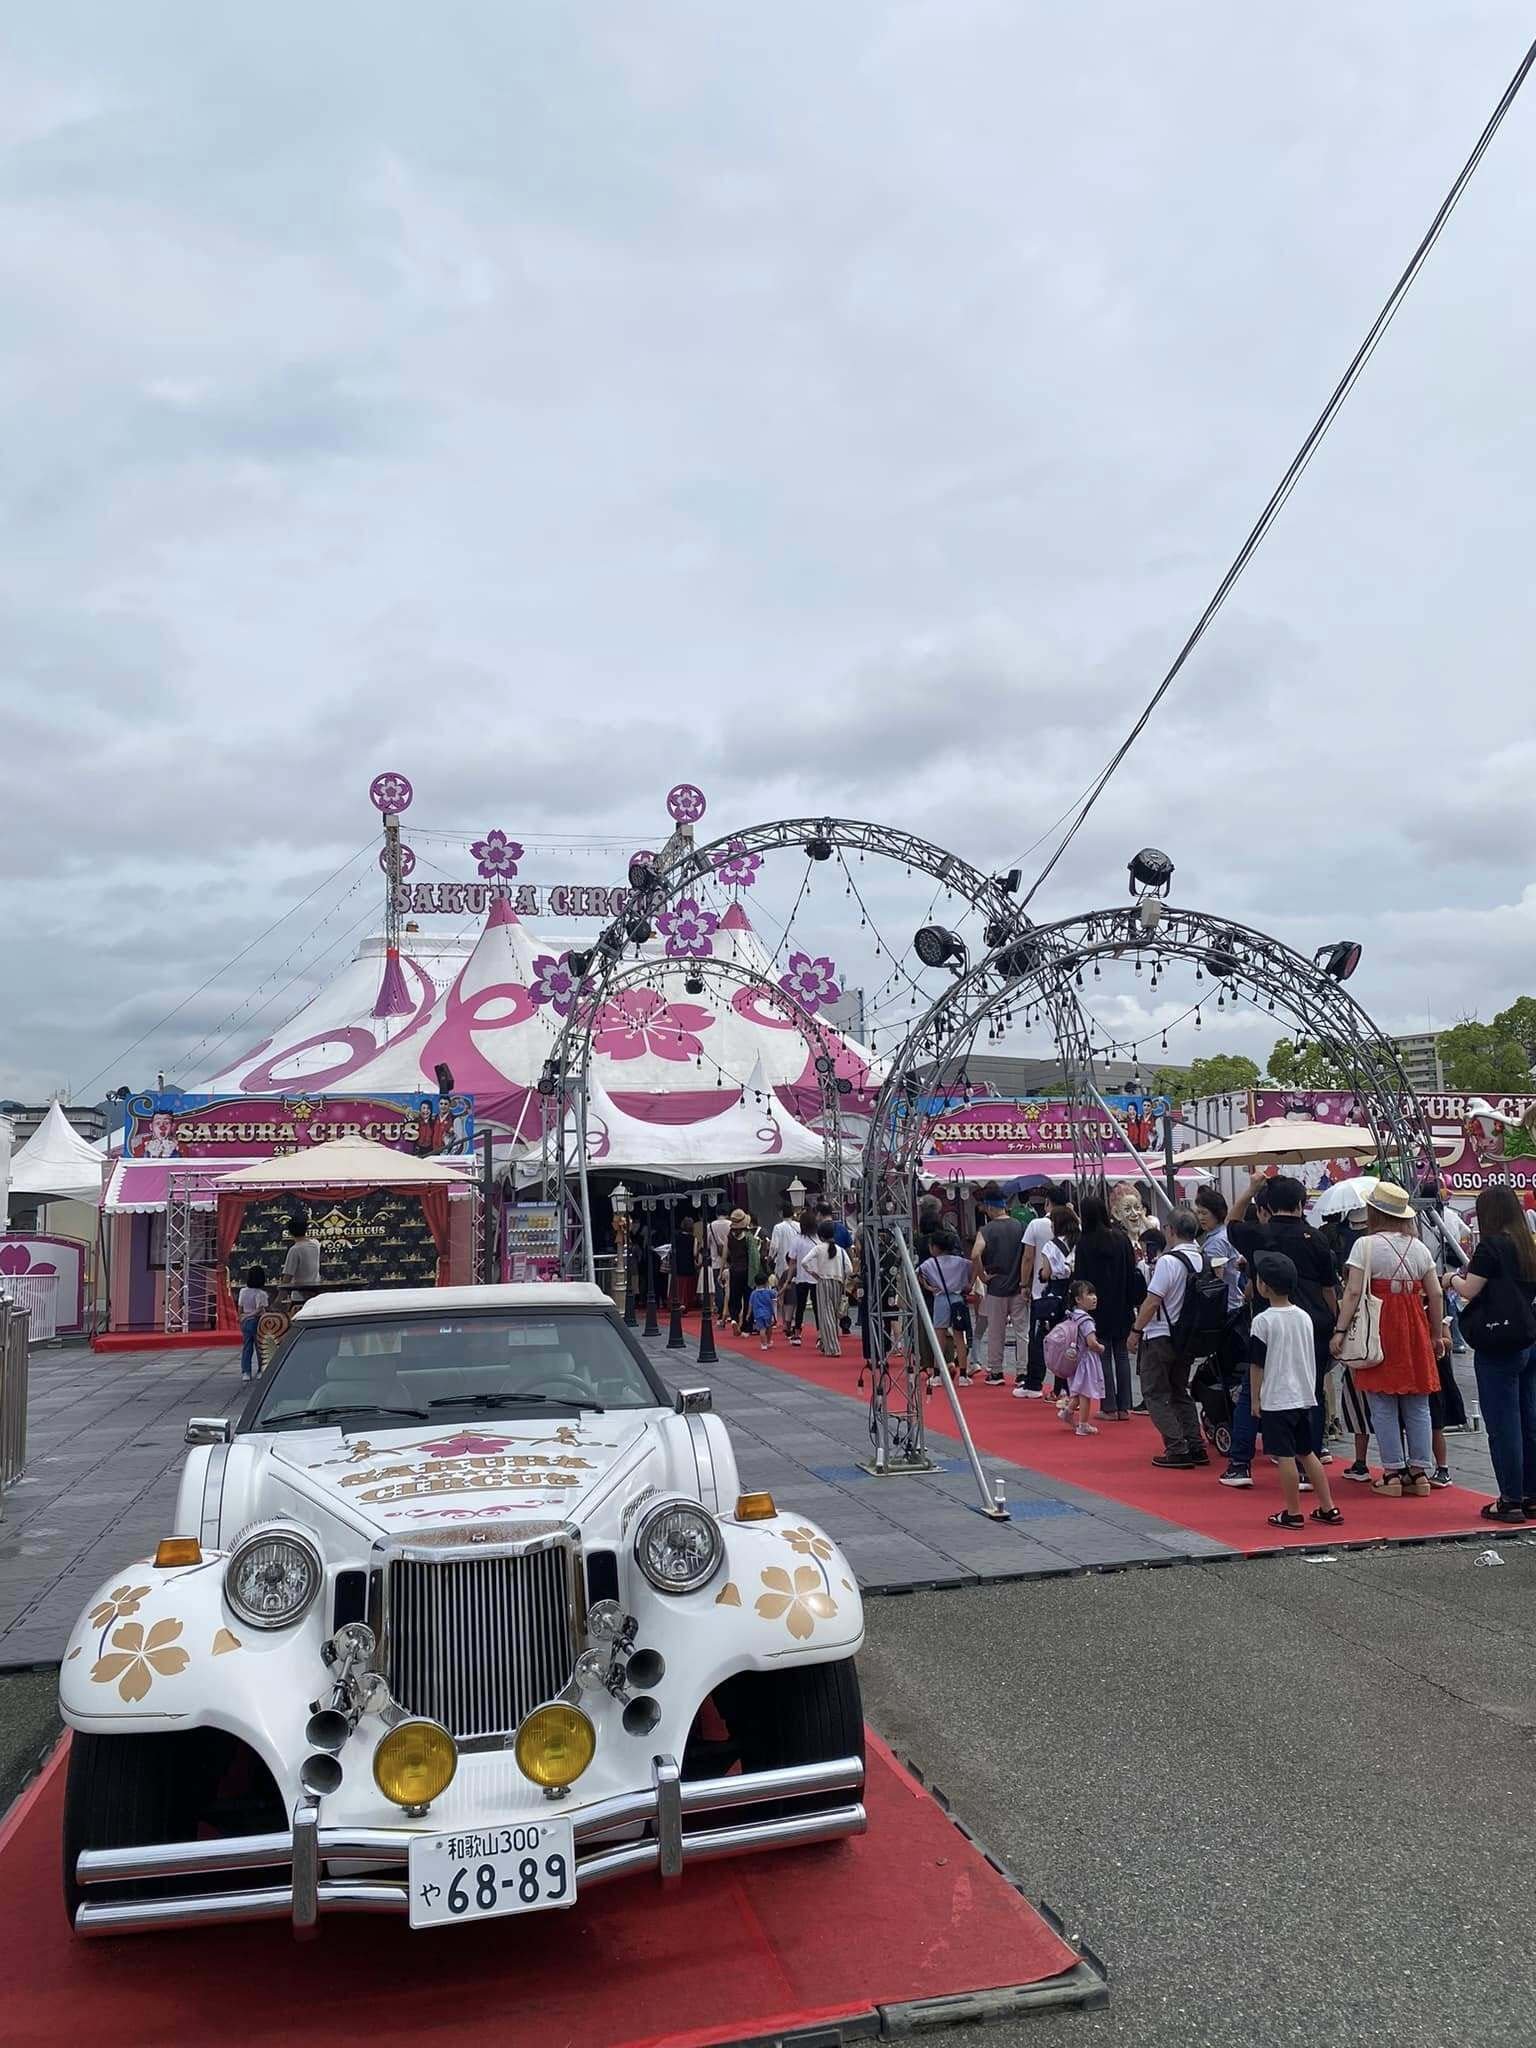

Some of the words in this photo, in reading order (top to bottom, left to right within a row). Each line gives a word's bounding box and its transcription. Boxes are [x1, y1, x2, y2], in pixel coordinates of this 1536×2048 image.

[176, 1122, 298, 1142] SAKURA
[309, 1122, 420, 1141] CIRCUS
[932, 1122, 1031, 1140] SAKURA
[282, 1228, 326, 1237] SURA
[343, 1226, 386, 1235] CIRCUS
[337, 1455, 597, 1487] SAKURA
[355, 1473, 581, 1501] CIRCUS
[448, 1826, 539, 1861] 和歌山300
[420, 1883, 441, 1907] や
[447, 1853, 567, 1914] 68-89
